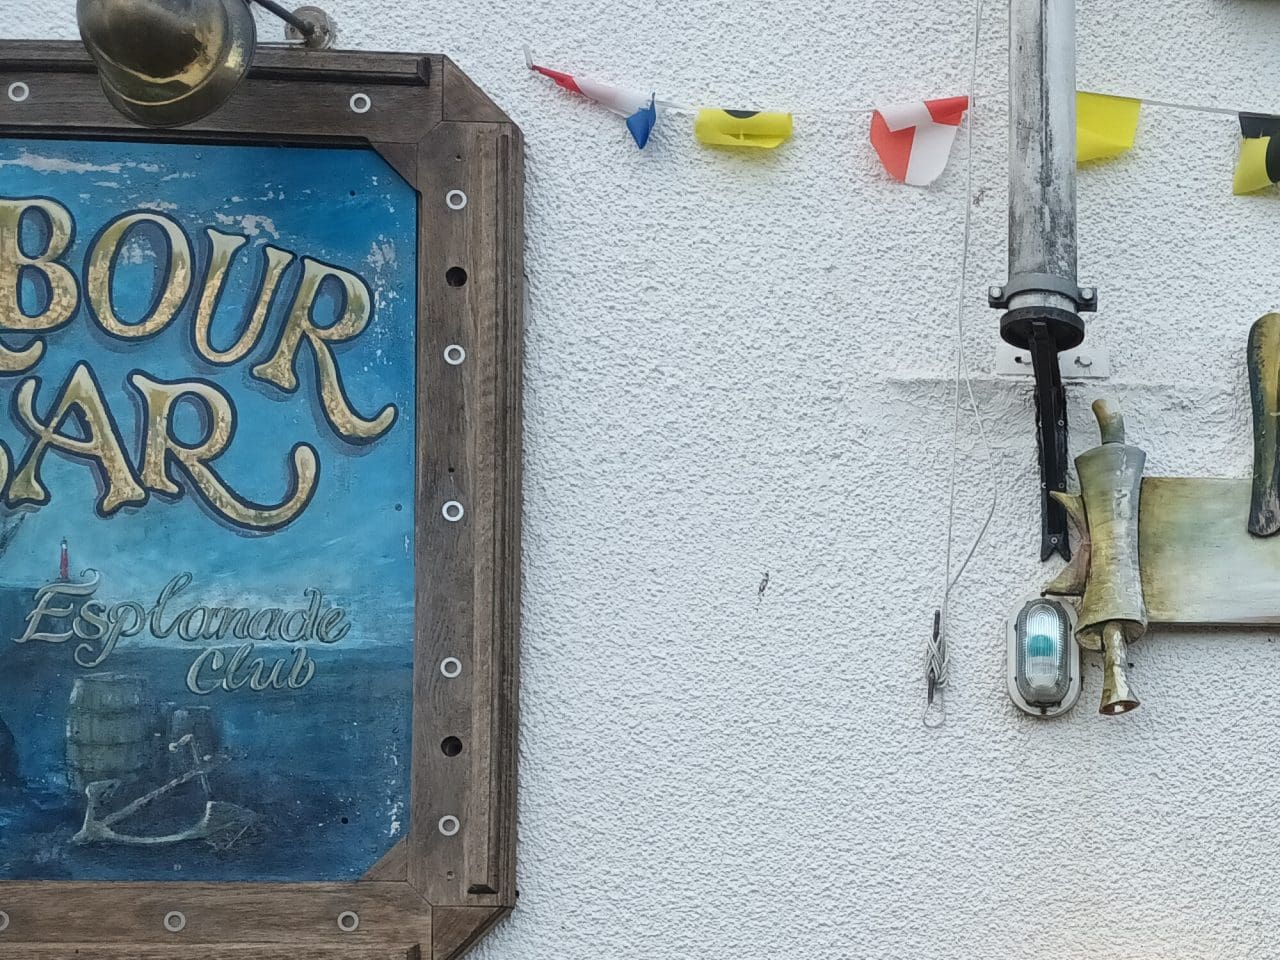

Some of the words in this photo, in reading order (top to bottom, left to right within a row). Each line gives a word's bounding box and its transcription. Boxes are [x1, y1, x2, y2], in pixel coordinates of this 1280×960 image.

[0, 195, 398, 445] BOUR
[0, 360, 321, 531] AR
[10, 568, 351, 668] Esplanade
[186, 643, 316, 696] Club
